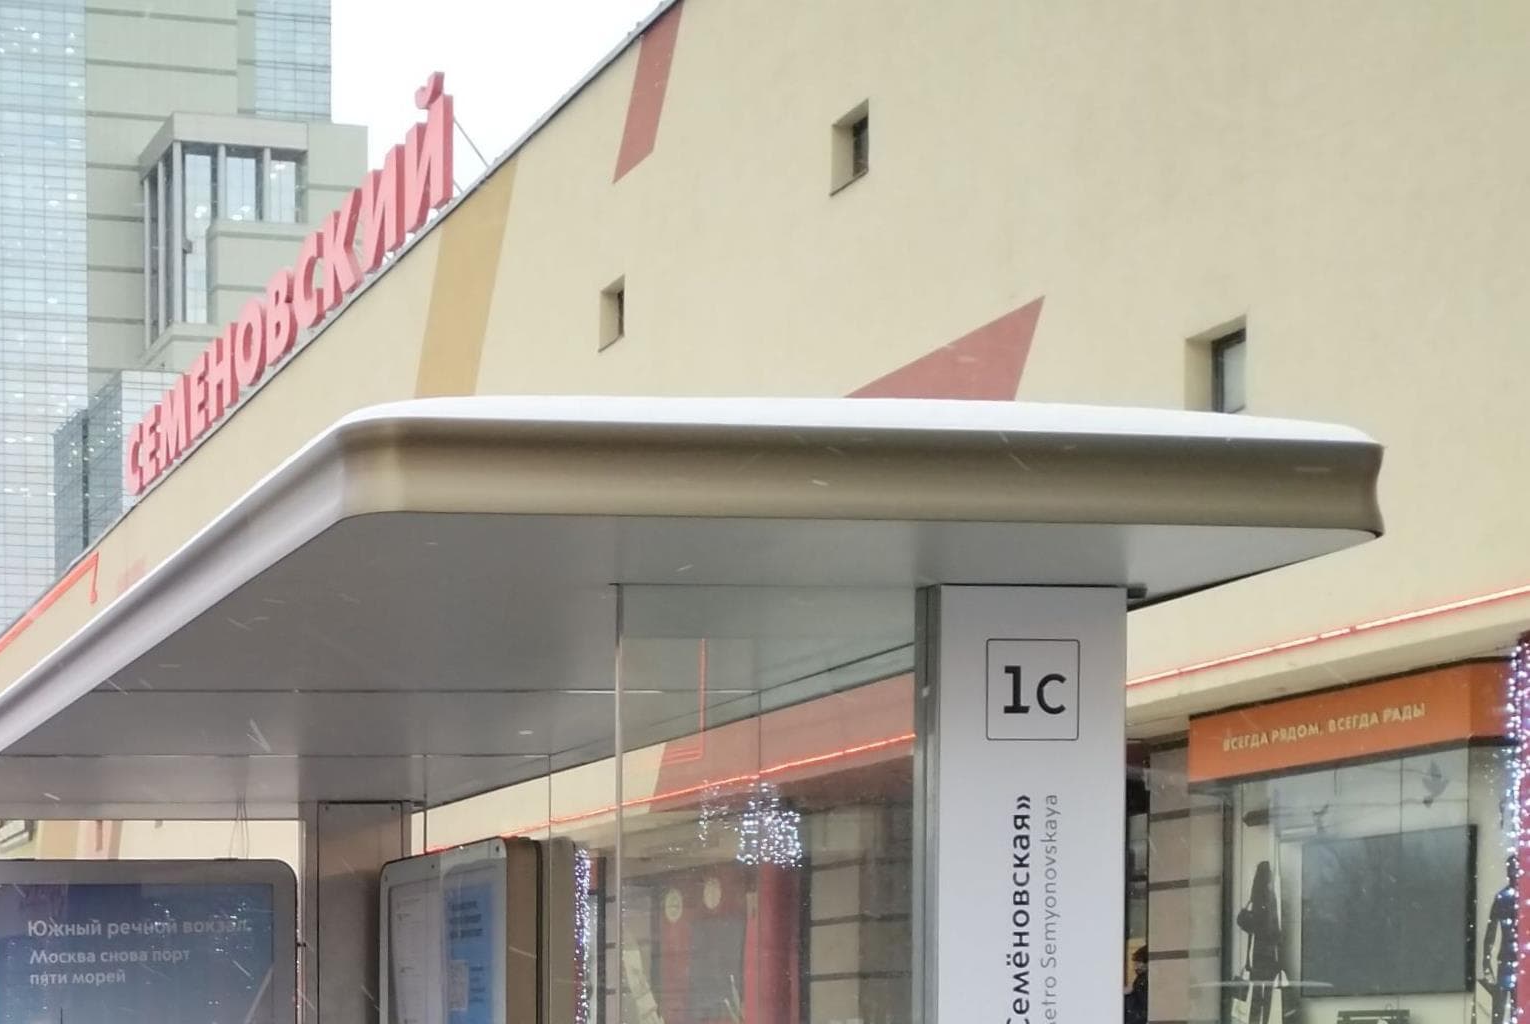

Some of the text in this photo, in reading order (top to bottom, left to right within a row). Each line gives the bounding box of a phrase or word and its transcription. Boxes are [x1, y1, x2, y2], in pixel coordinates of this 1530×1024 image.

[127, 72, 454, 497] СЕМЕНОВСКИЙ
[1223, 733, 1269, 752] ВСЕГДА
[1328, 712, 1379, 733] ВСЕГДА
[1382, 703, 1425, 724] РАДЫ
[1040, 794, 1062, 969] Semyonovskaya
[27, 919, 102, 937] Южный
[107, 918, 178, 939] речной
[30, 949, 190, 964] Москва снова порт
[30, 969, 126, 987] пяти морей
